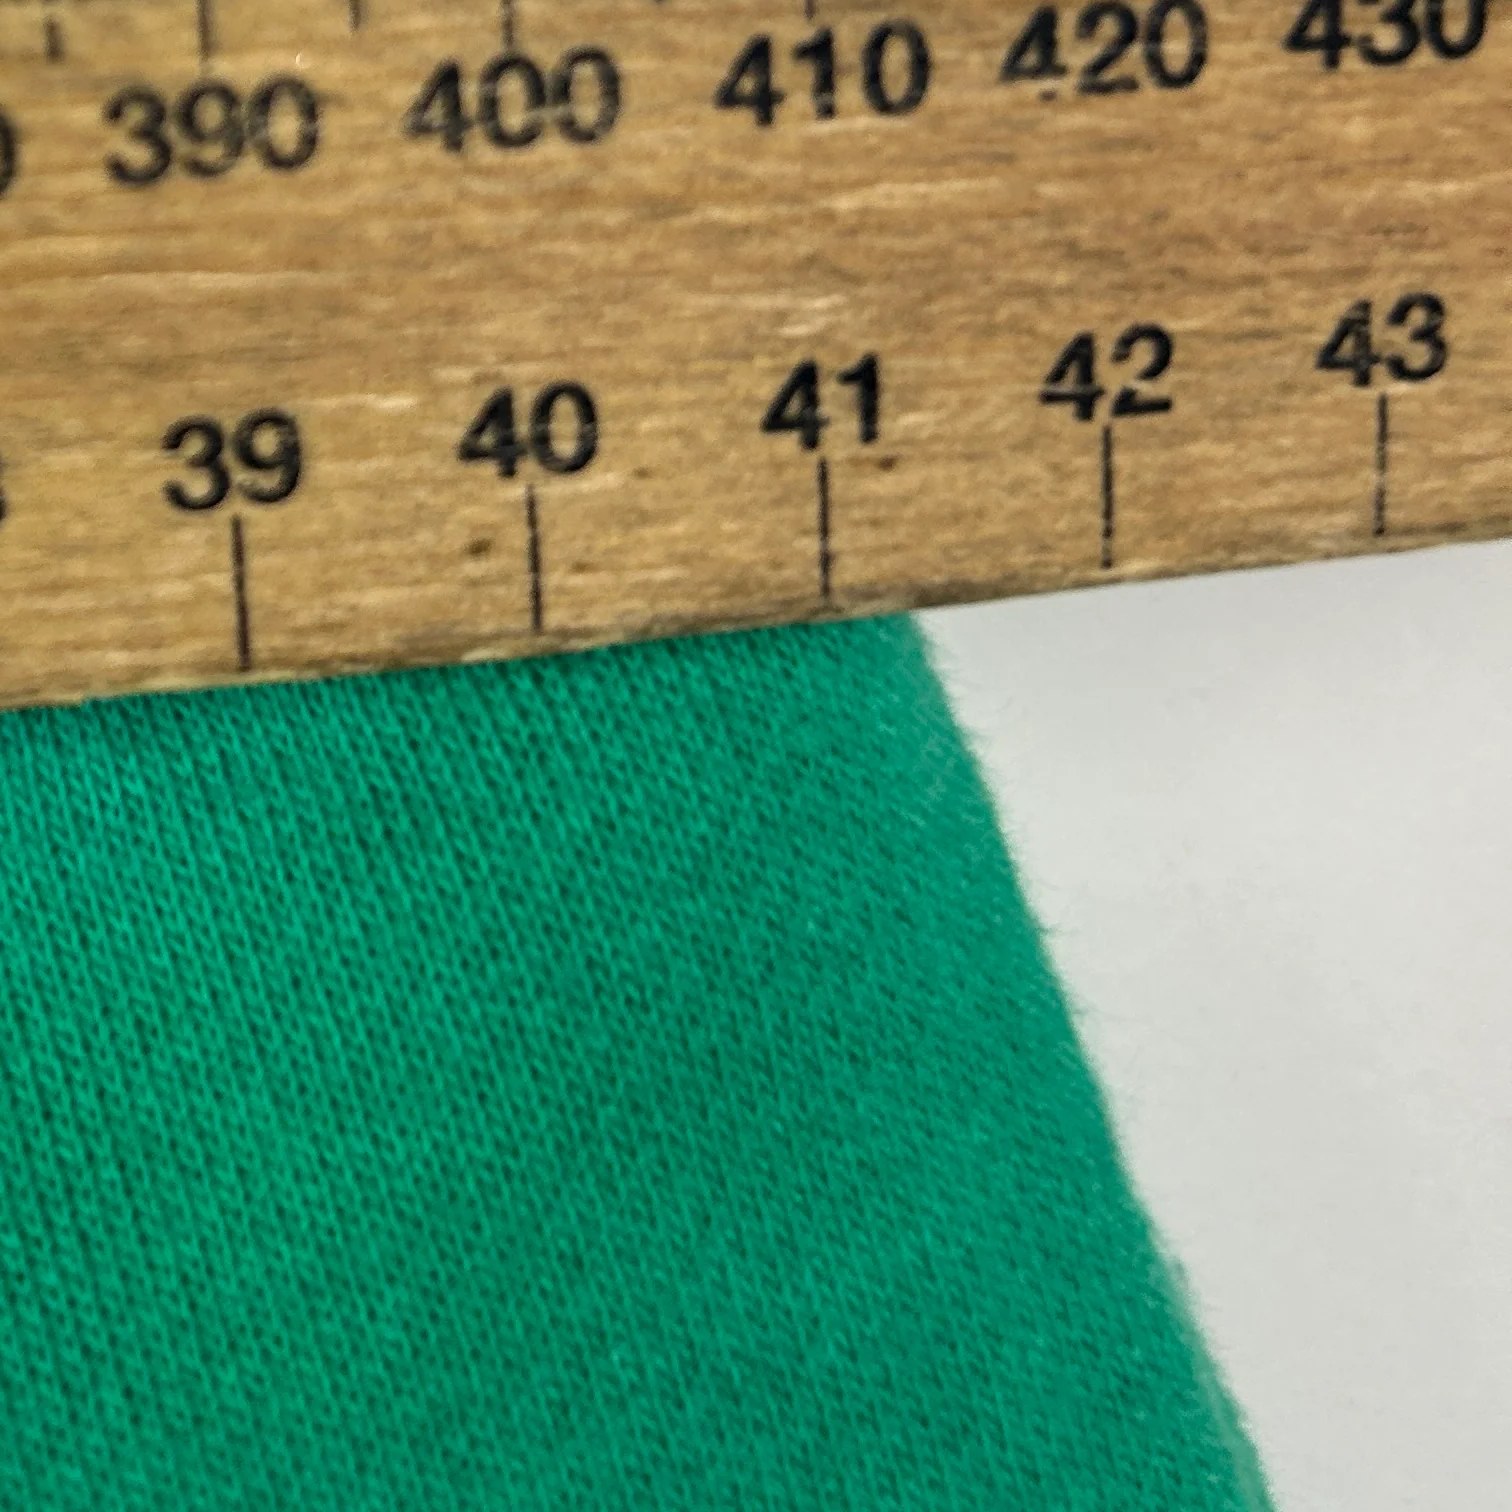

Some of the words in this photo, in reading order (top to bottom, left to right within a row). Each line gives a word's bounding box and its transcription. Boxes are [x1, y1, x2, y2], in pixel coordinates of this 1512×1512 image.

[103, 75, 323, 187] 390
[406, 45, 621, 153] 400
[716, 17, 930, 126] 410
[163, 407, 303, 513] 39
[460, 380, 599, 478] 40
[762, 350, 882, 450] 41
[1041, 323, 1175, 421] 42
[1317, 291, 1449, 387] 43
